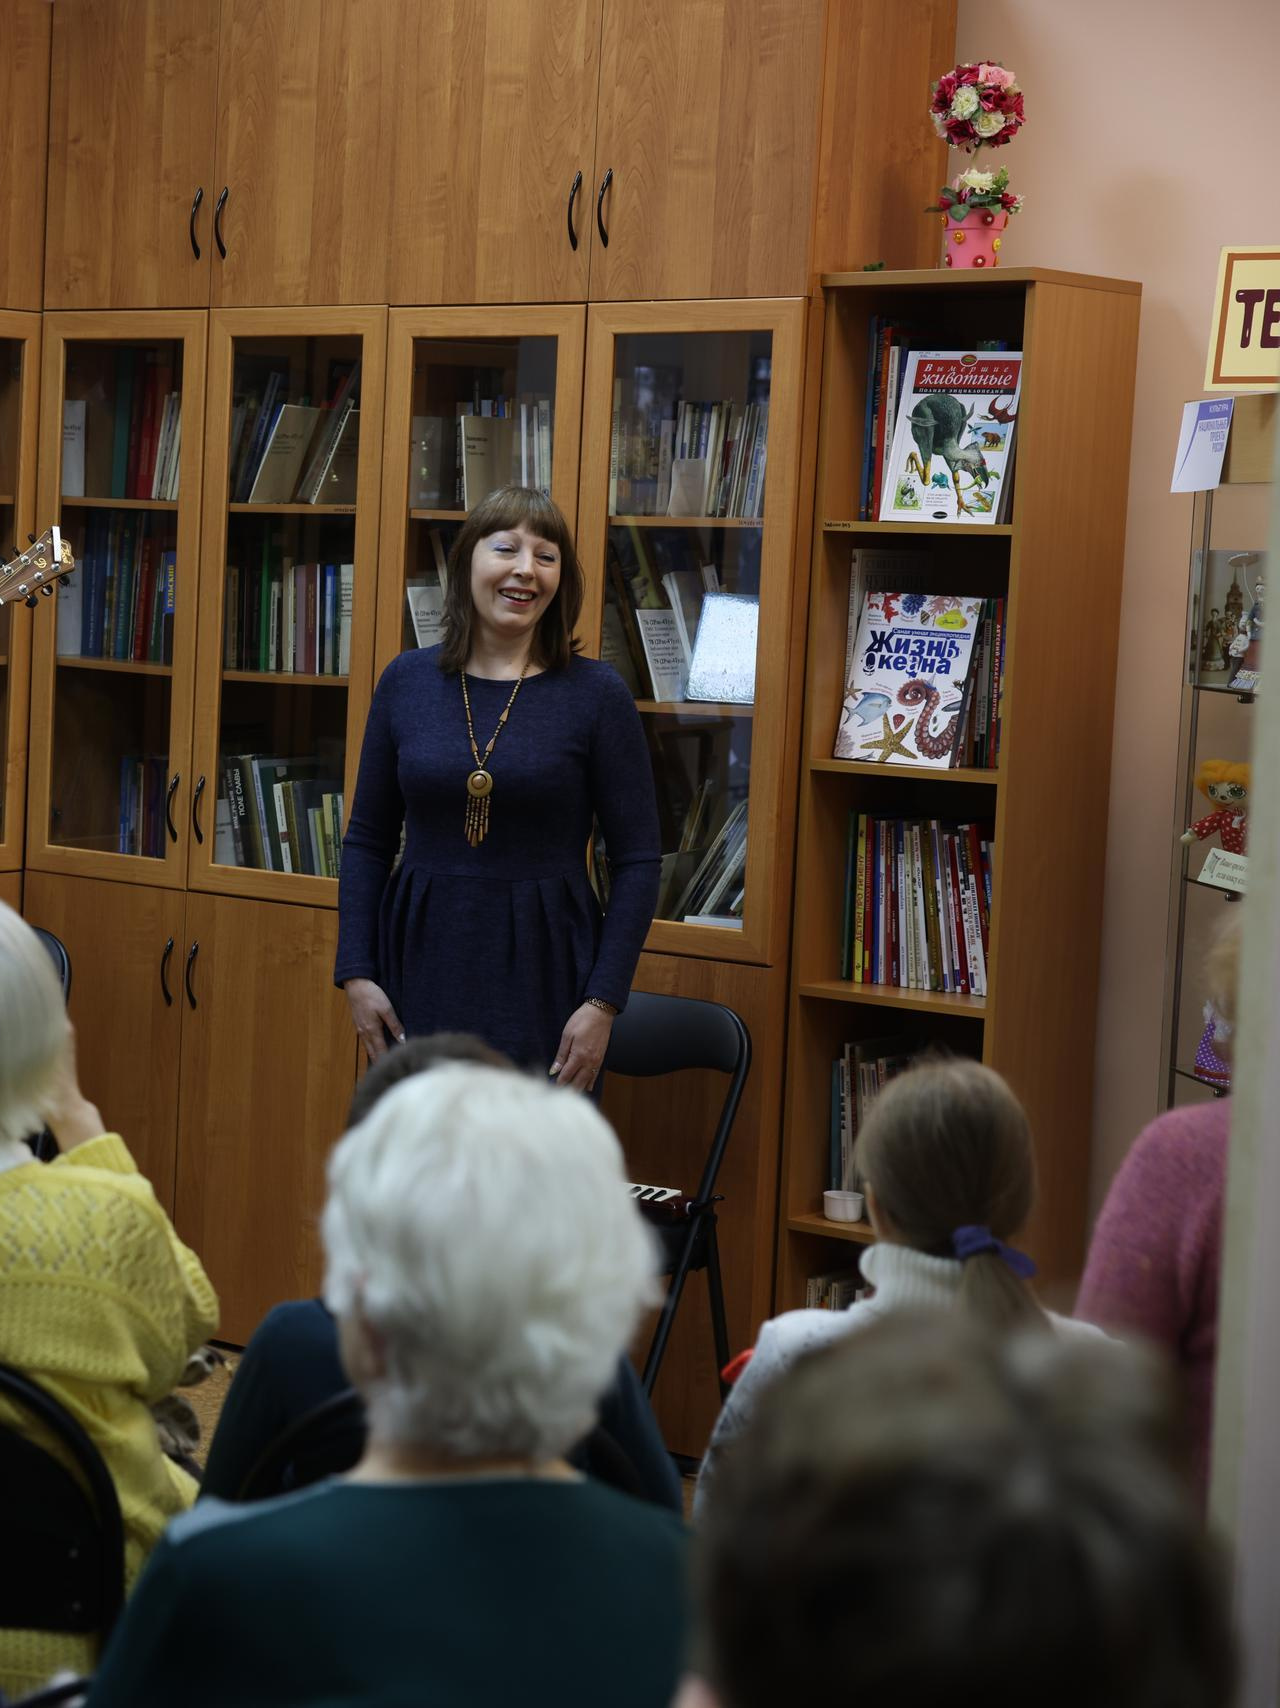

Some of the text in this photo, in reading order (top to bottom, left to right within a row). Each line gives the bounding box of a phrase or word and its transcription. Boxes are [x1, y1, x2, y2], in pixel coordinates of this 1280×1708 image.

[918, 372, 1013, 386] животные
[866, 630, 960, 659] Жизнь
[233, 768, 246, 816] ПОЛЕ СЛАВЫ
